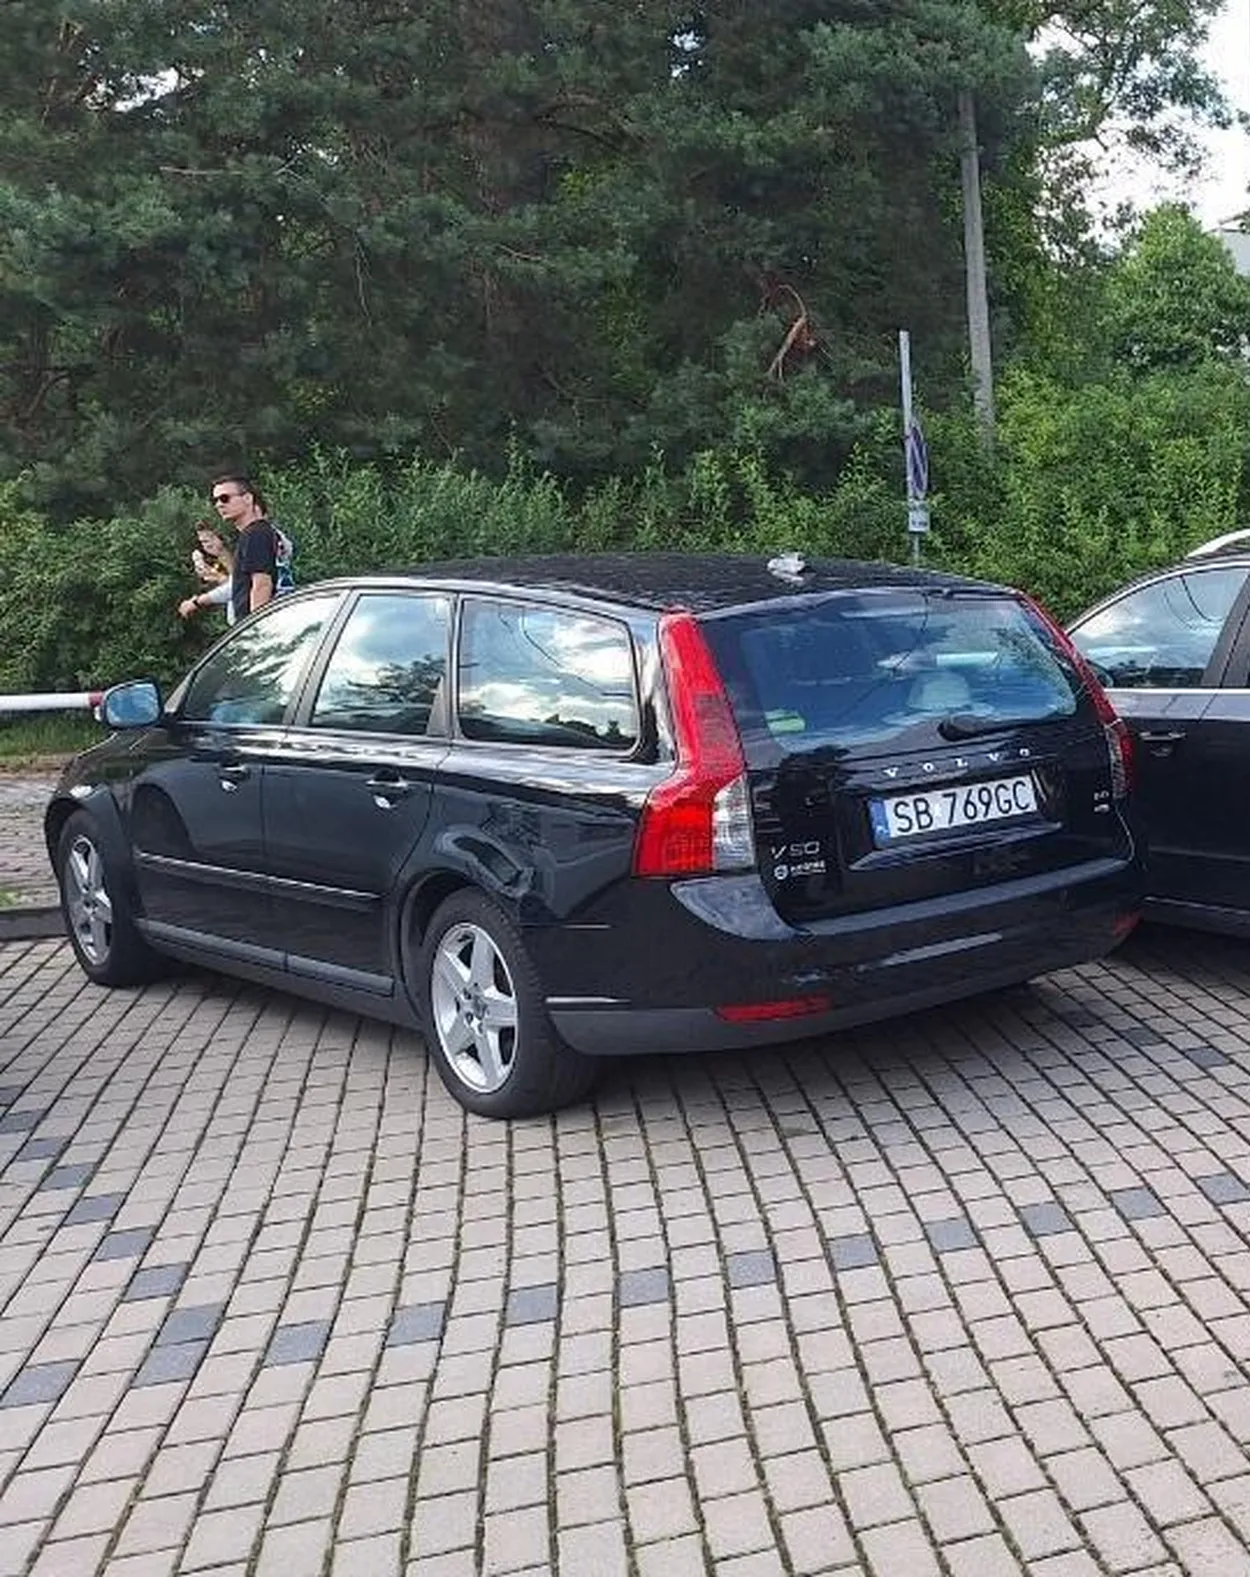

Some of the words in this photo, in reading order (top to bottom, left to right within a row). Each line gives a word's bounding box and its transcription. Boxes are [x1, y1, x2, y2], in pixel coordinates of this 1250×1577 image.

[883, 748, 1030, 777] VOLVO
[893, 798, 934, 833] SB
[941, 781, 1031, 825] 769GC
